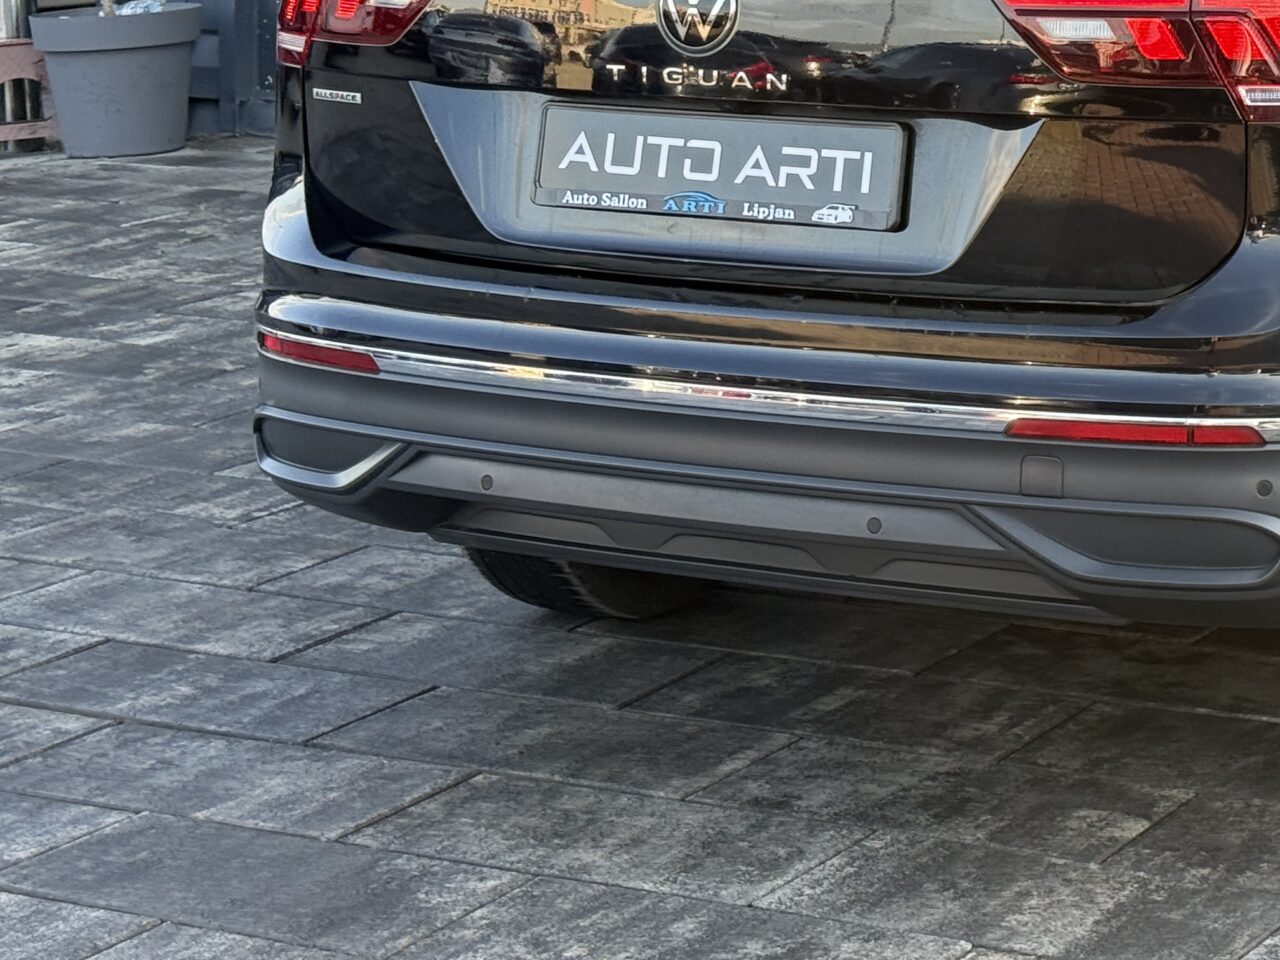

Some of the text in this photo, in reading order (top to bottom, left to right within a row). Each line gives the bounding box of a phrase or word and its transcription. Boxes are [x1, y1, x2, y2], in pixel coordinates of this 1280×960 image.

[606, 64, 789, 92] TIGUAN
[314, 90, 358, 102] ALLSPACE
[558, 130, 874, 194] AUTO ARTI
[562, 190, 598, 207] Auto
[662, 199, 727, 216] ARTI
[742, 202, 795, 220] Lipjan
